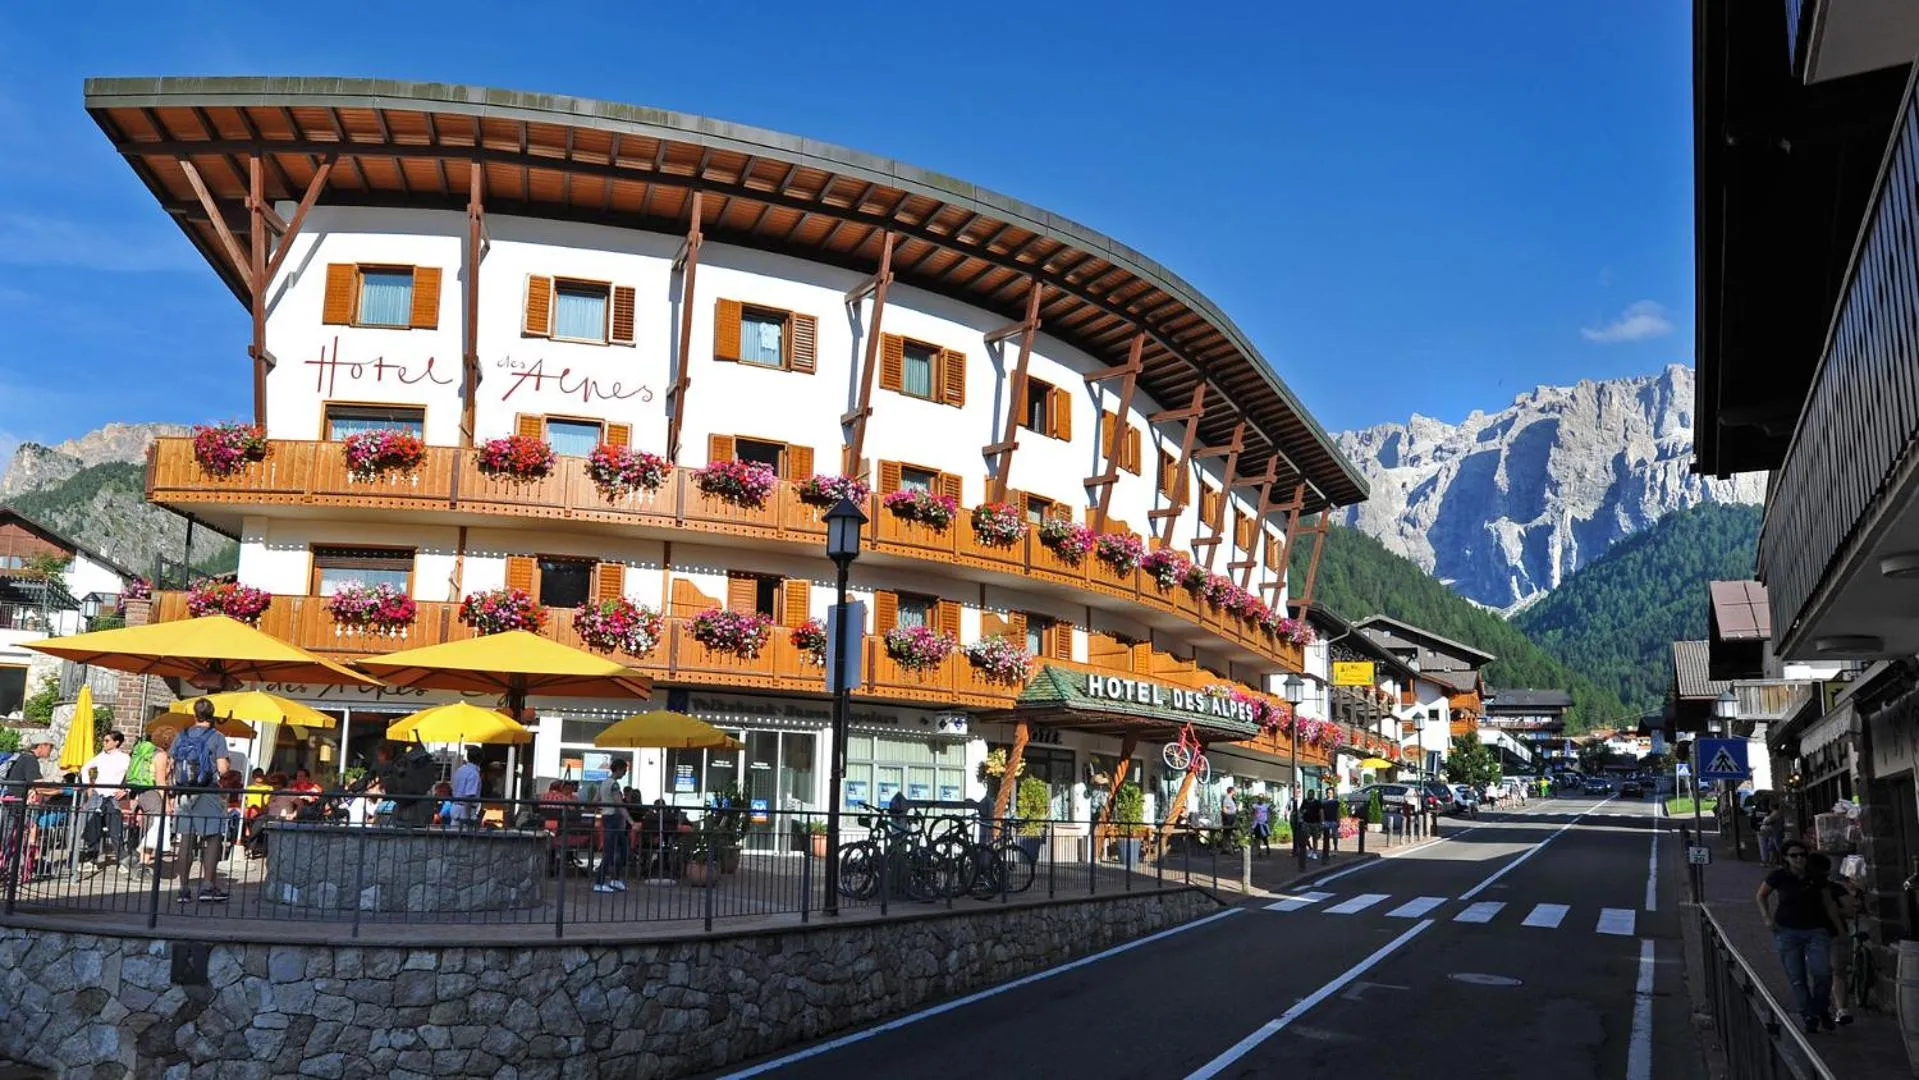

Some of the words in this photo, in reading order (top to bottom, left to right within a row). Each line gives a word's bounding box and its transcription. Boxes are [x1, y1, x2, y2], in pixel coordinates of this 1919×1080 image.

[304, 336, 454, 397] Hotel
[497, 356, 526, 368] des
[501, 358, 653, 402] Alpes
[1089, 674, 1163, 705] HOTEL
[1173, 688, 1205, 712] DES
[1212, 697, 1254, 722] ALPES
